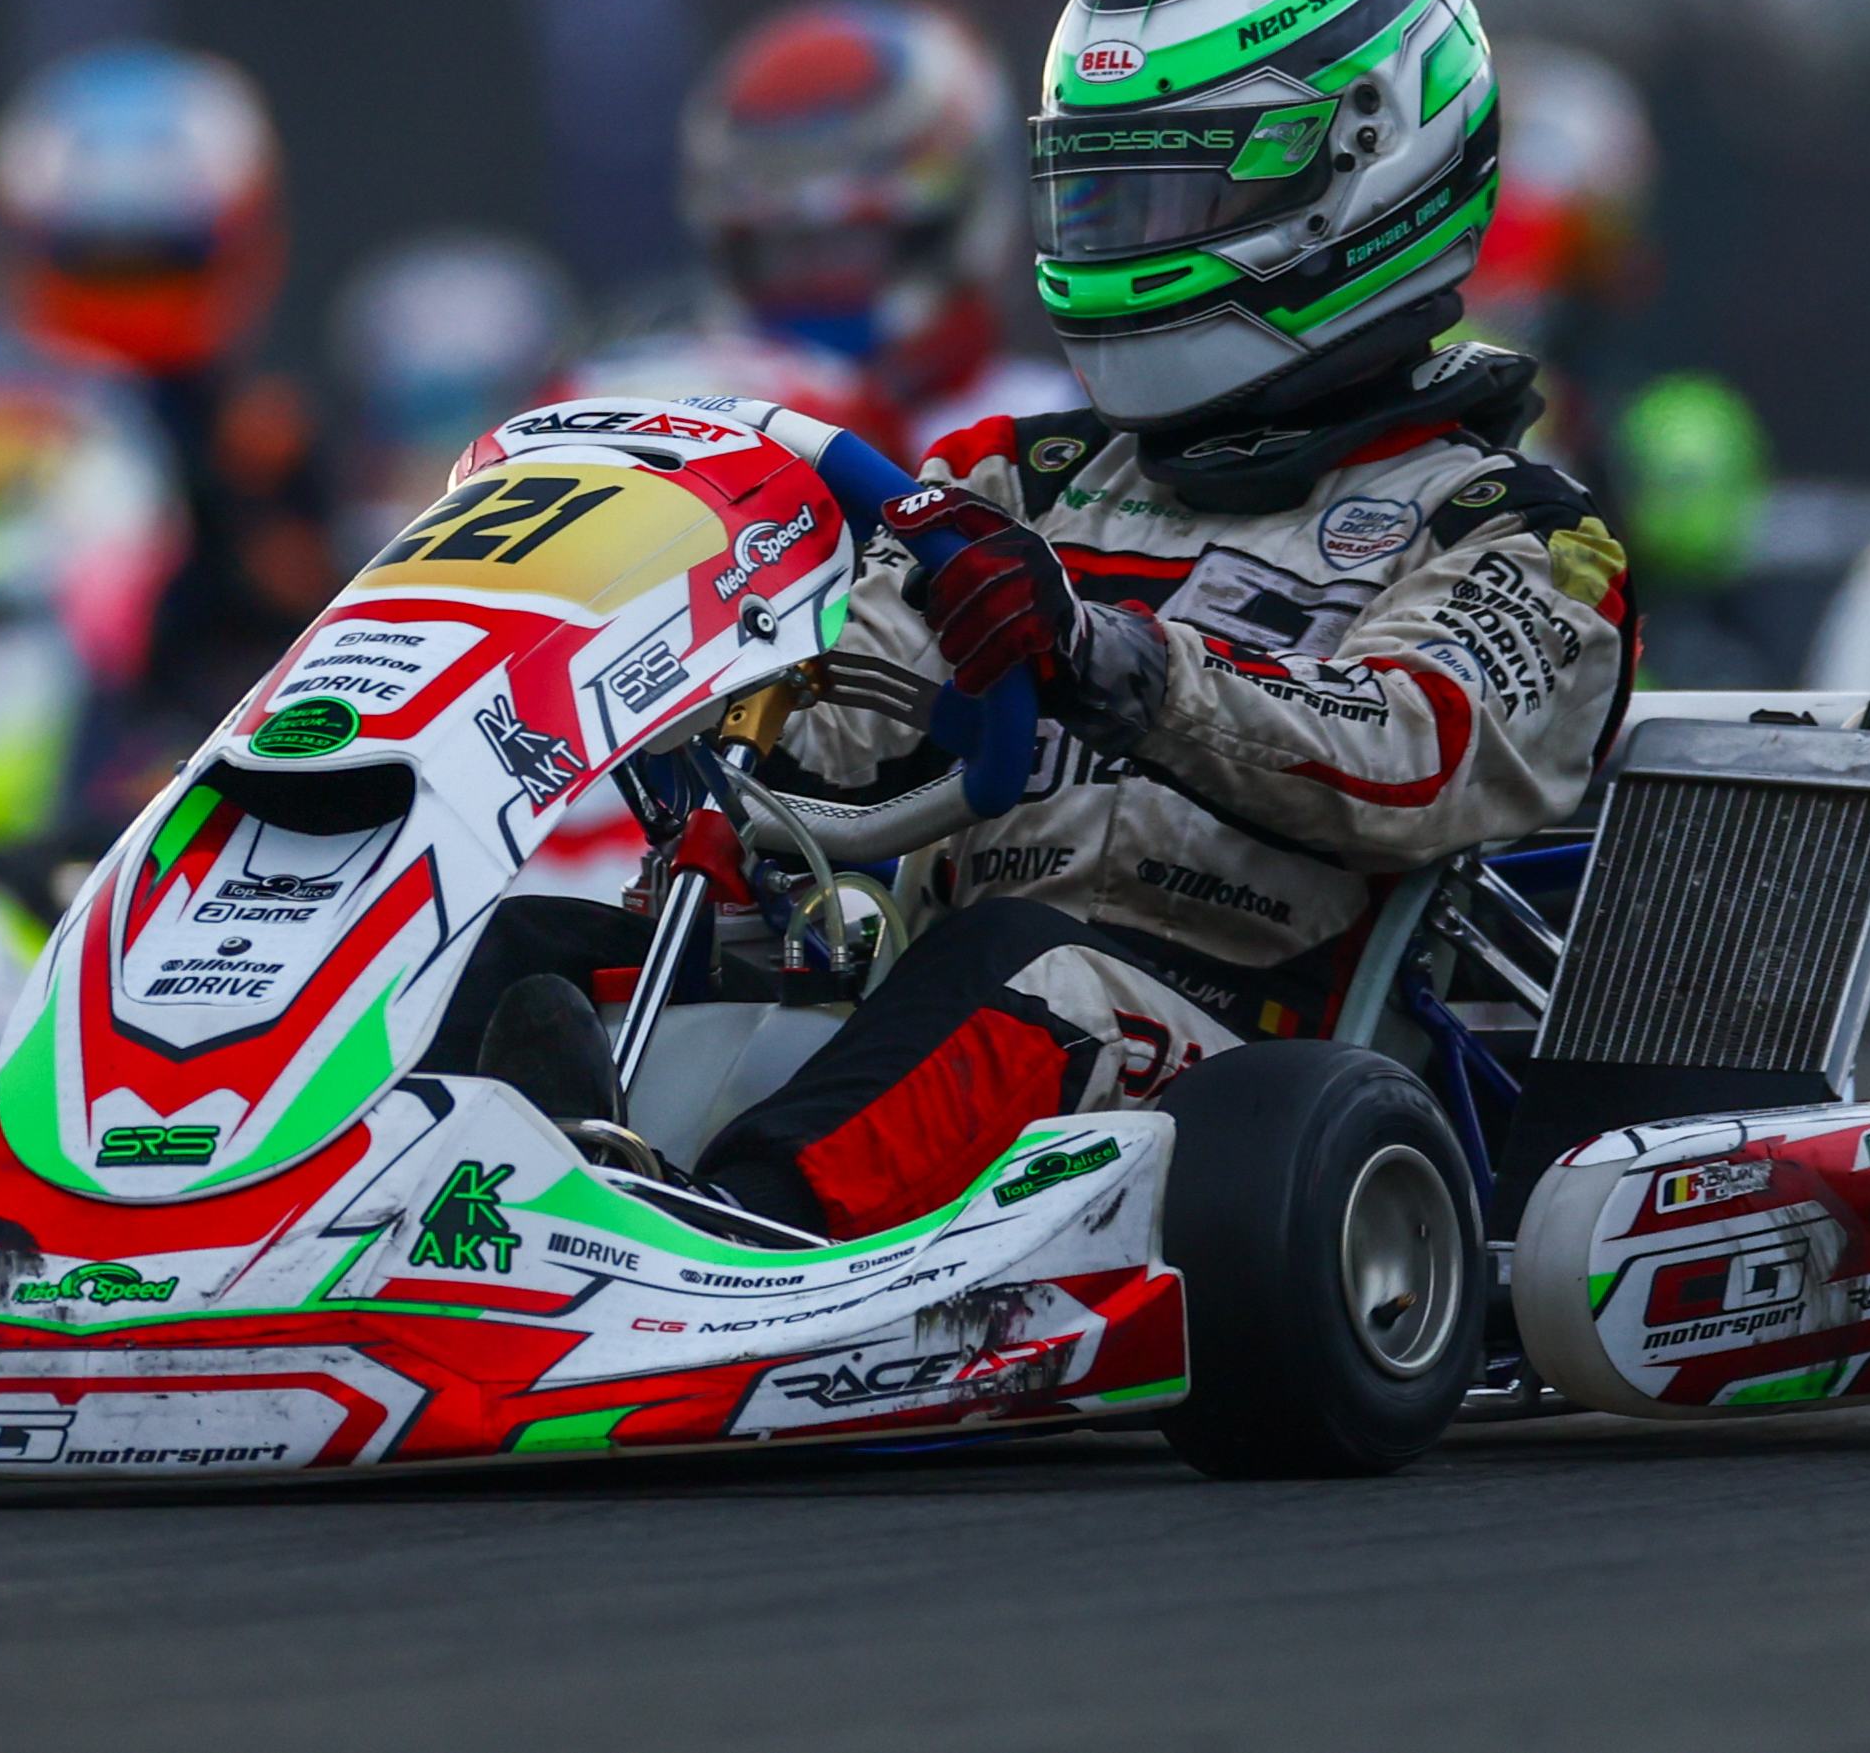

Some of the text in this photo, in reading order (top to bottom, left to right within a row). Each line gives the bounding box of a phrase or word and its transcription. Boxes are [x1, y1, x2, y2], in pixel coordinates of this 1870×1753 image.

[1082, 50, 1134, 72] BELL
[363, 477, 625, 573] 221
[611, 643, 680, 705] SRS
[1432, 649, 1476, 683] DAUW
[521, 739, 584, 804] AKT
[100, 1127, 218, 1158] SRS
[410, 1231, 518, 1271] AKT
[568, 1237, 641, 1272] DRIVE
[701, 1271, 805, 1289] Tillotson
[631, 1317, 688, 1334] CG
[1642, 1301, 1807, 1349] motorsport
[64, 1444, 291, 1466] motorsport
